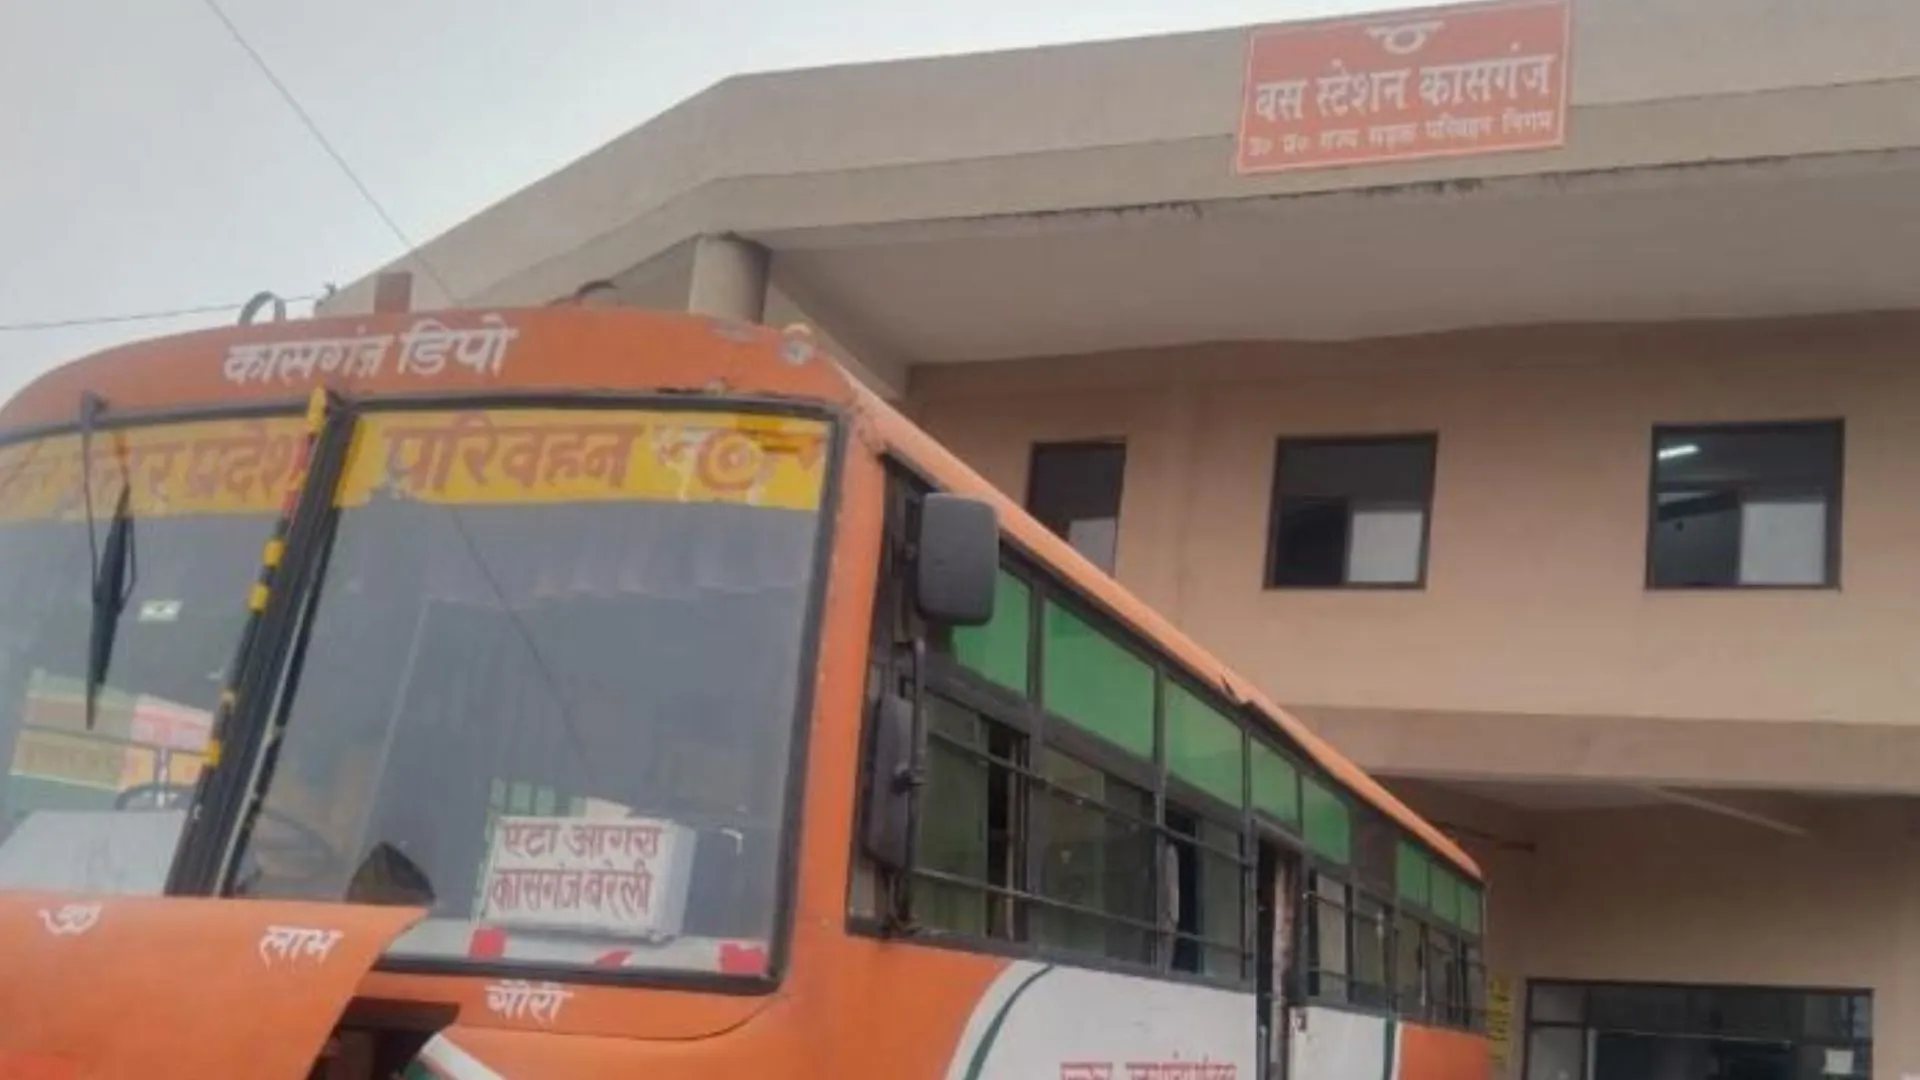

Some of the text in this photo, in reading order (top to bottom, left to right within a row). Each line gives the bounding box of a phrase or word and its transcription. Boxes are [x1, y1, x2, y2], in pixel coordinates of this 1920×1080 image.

[1316, 58, 1411, 118] स्टेशन
[1419, 42, 1557, 106] कासगंज
[224, 313, 520, 385] कासगंज डिपो
[383, 409, 645, 491] परिवहन
[504, 822, 662, 860] एटा आगरा
[259, 924, 344, 967] लाभ
